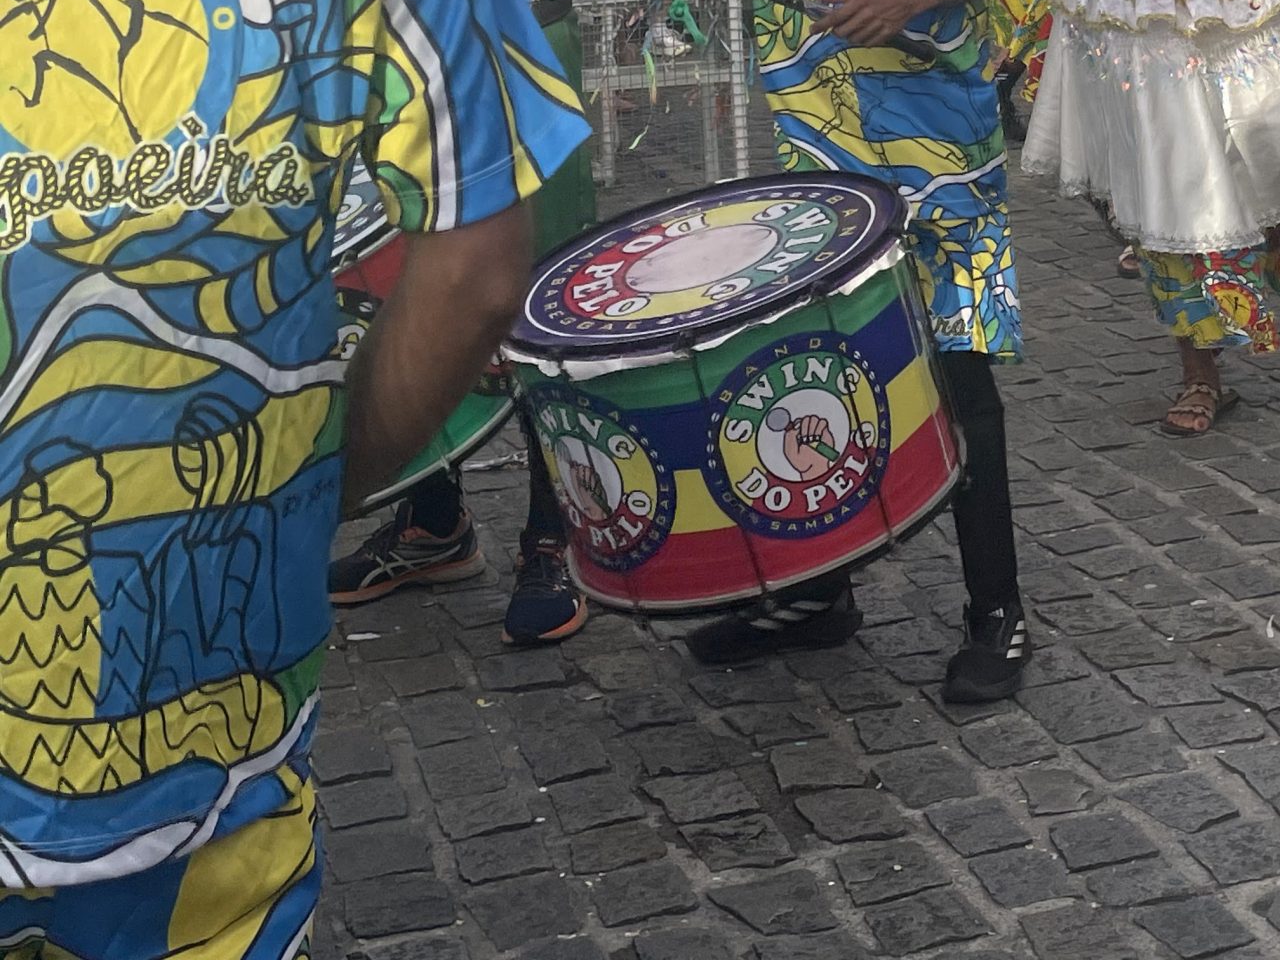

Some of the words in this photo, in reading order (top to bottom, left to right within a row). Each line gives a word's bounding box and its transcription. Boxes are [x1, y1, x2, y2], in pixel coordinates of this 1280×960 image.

[621, 213, 709, 254] DO
[704, 202, 831, 300] SWING
[720, 338, 847, 403] BANDA
[725, 357, 861, 444] SWING
[736, 467, 790, 512] DO
[770, 504, 852, 531] SAMBA
